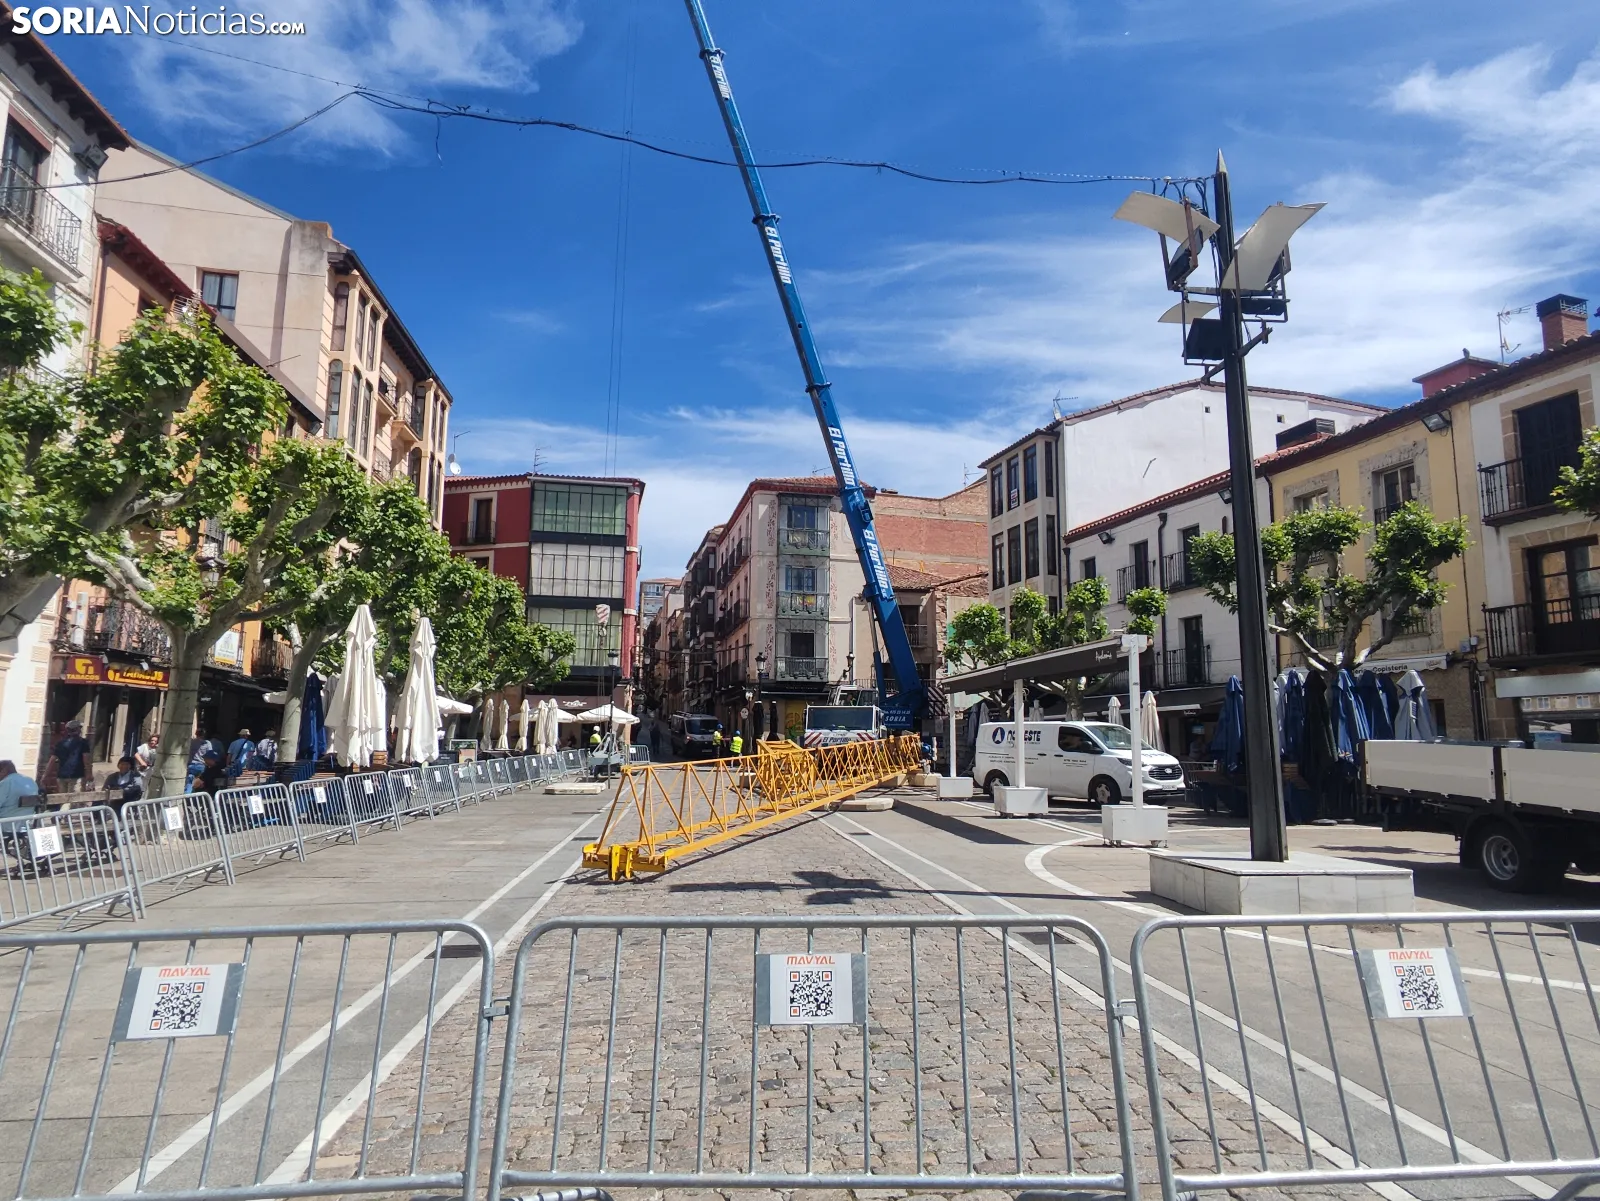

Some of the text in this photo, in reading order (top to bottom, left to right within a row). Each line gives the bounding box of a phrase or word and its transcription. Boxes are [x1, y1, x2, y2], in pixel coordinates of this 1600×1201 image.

[711, 64, 730, 98] Portillo
[764, 226, 792, 284] El Portillo
[828, 426, 855, 486] El Portillo
[862, 529, 876, 541] El
[866, 542, 889, 588] Portillo
[1007, 730, 1041, 741] NOESTE
[786, 956, 835, 965] MAVYAL
[1389, 951, 1433, 960] MAVYAL
[158, 967, 211, 977] MAVYAL
